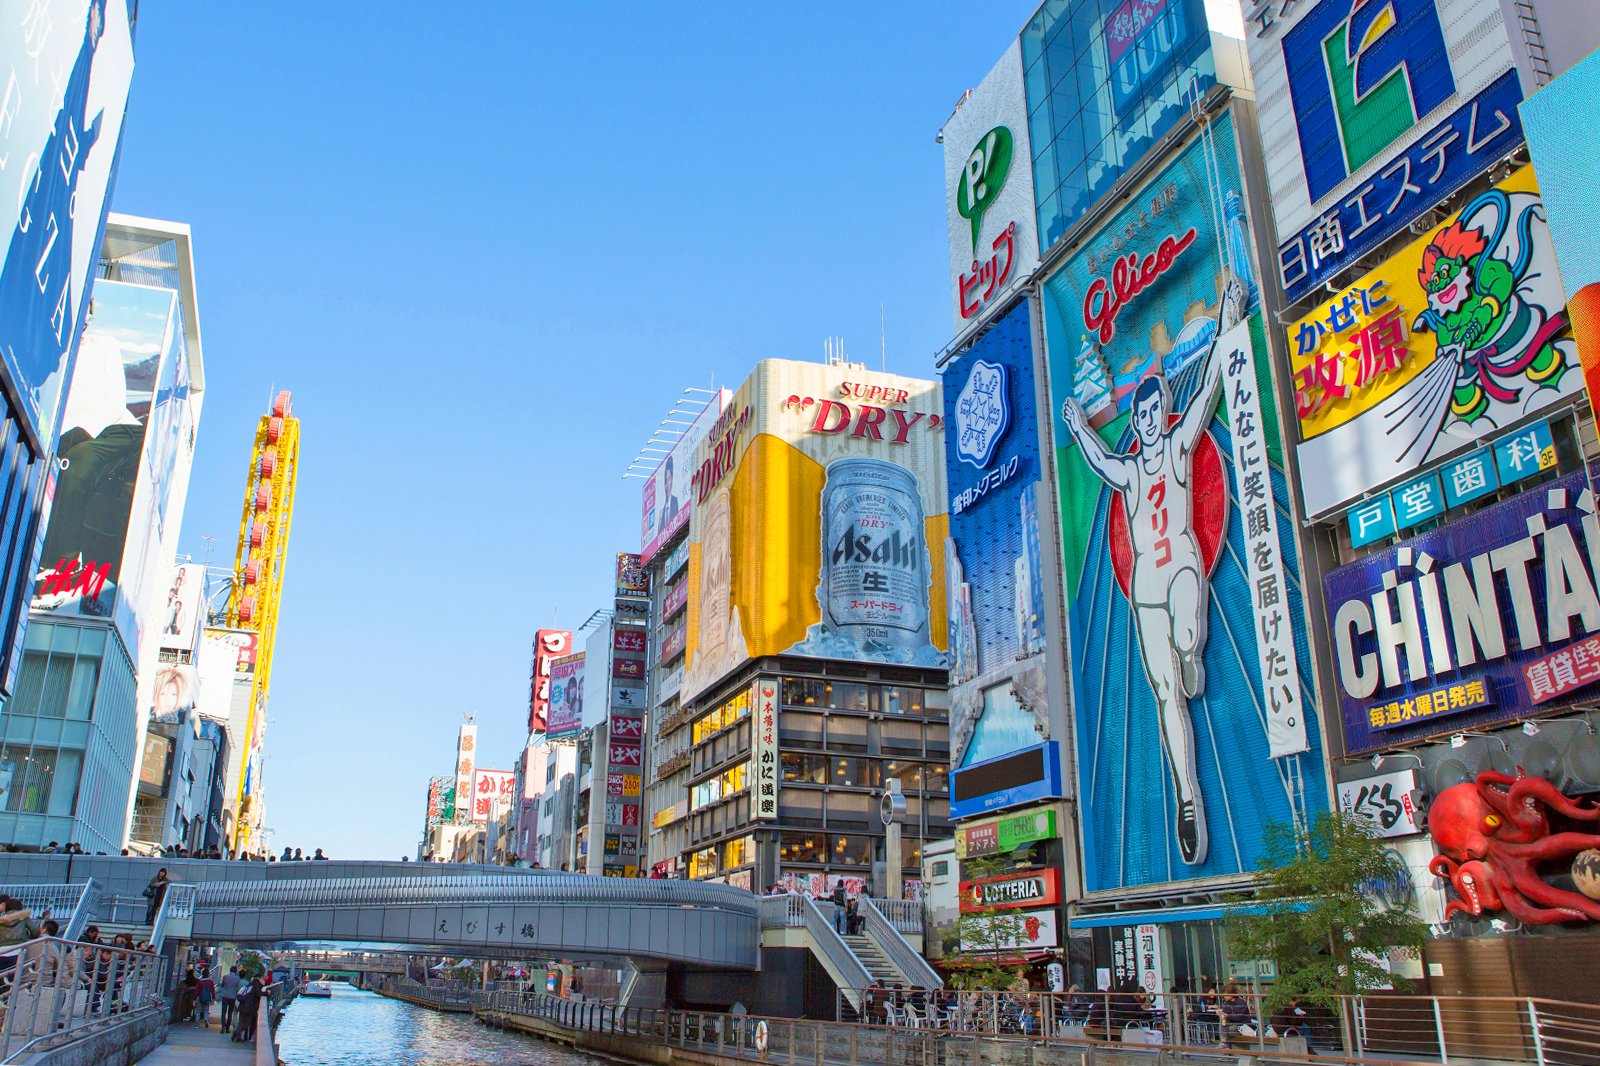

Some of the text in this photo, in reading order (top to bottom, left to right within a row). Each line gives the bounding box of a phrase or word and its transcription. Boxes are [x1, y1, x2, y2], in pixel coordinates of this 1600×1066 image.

[1278, 101, 1511, 290] 日商エステム
[957, 220, 1017, 320] ピップ
[1083, 227, 1198, 342] Glico
[1295, 279, 1392, 357] かぜに
[1291, 304, 1412, 422] 改源
[840, 381, 910, 404] SUPER
[707, 402, 734, 450] SUPER
[1541, 449, 1555, 466] 3F
[952, 454, 1020, 514] 雪印メグミルク
[1359, 431, 1542, 538] 戸堂歯科
[1145, 473, 1174, 569] グリコ
[1227, 347, 1298, 728] みんなに笑顔を届けたい。
[832, 525, 917, 572] Asahi
[40, 556, 112, 603] H&M
[861, 571, 890, 593] 生
[850, 599, 904, 613] スーパードライ
[865, 627, 889, 638] 350ml
[1526, 650, 1579, 700] 賃貸
[762, 700, 774, 746] 本場の味
[1368, 680, 1486, 728] 毎週水曜日発売
[477, 774, 516, 796] かに
[983, 879, 1039, 903] LOTTERIA
[438, 919, 535, 939] えびす橋
